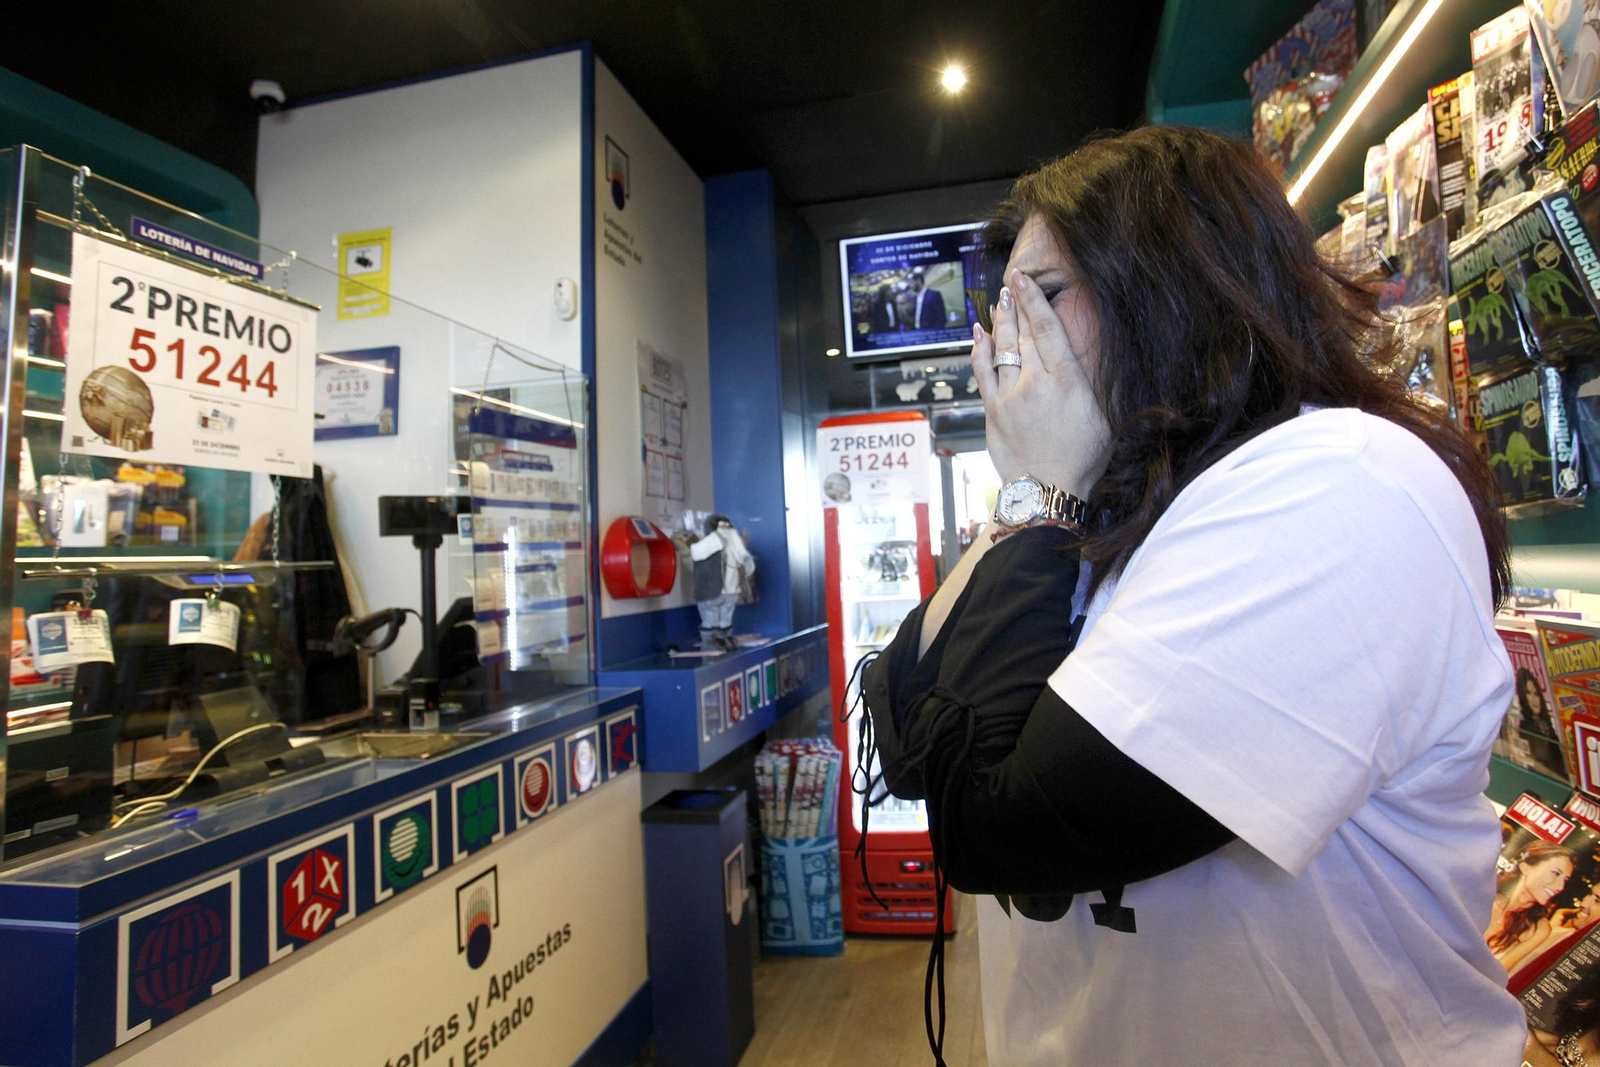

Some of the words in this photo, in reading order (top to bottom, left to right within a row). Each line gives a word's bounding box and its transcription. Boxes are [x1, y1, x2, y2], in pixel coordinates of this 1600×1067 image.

[1484, 101, 1532, 154] 198
[140, 225, 193, 253] LOTERÍA
[194, 244, 211, 259] DE
[212, 251, 259, 276] NAVIDAD
[148, 287, 293, 354] PREMIO
[127, 327, 279, 399] 51244
[839, 451, 909, 473] 51244
[844, 433, 915, 451] PREMIO
[1513, 796, 1570, 839] ¡HOLA!
[467, 995, 480, 1032] y
[486, 921, 572, 1009] Apuestas
[463, 995, 534, 1067] Estado
